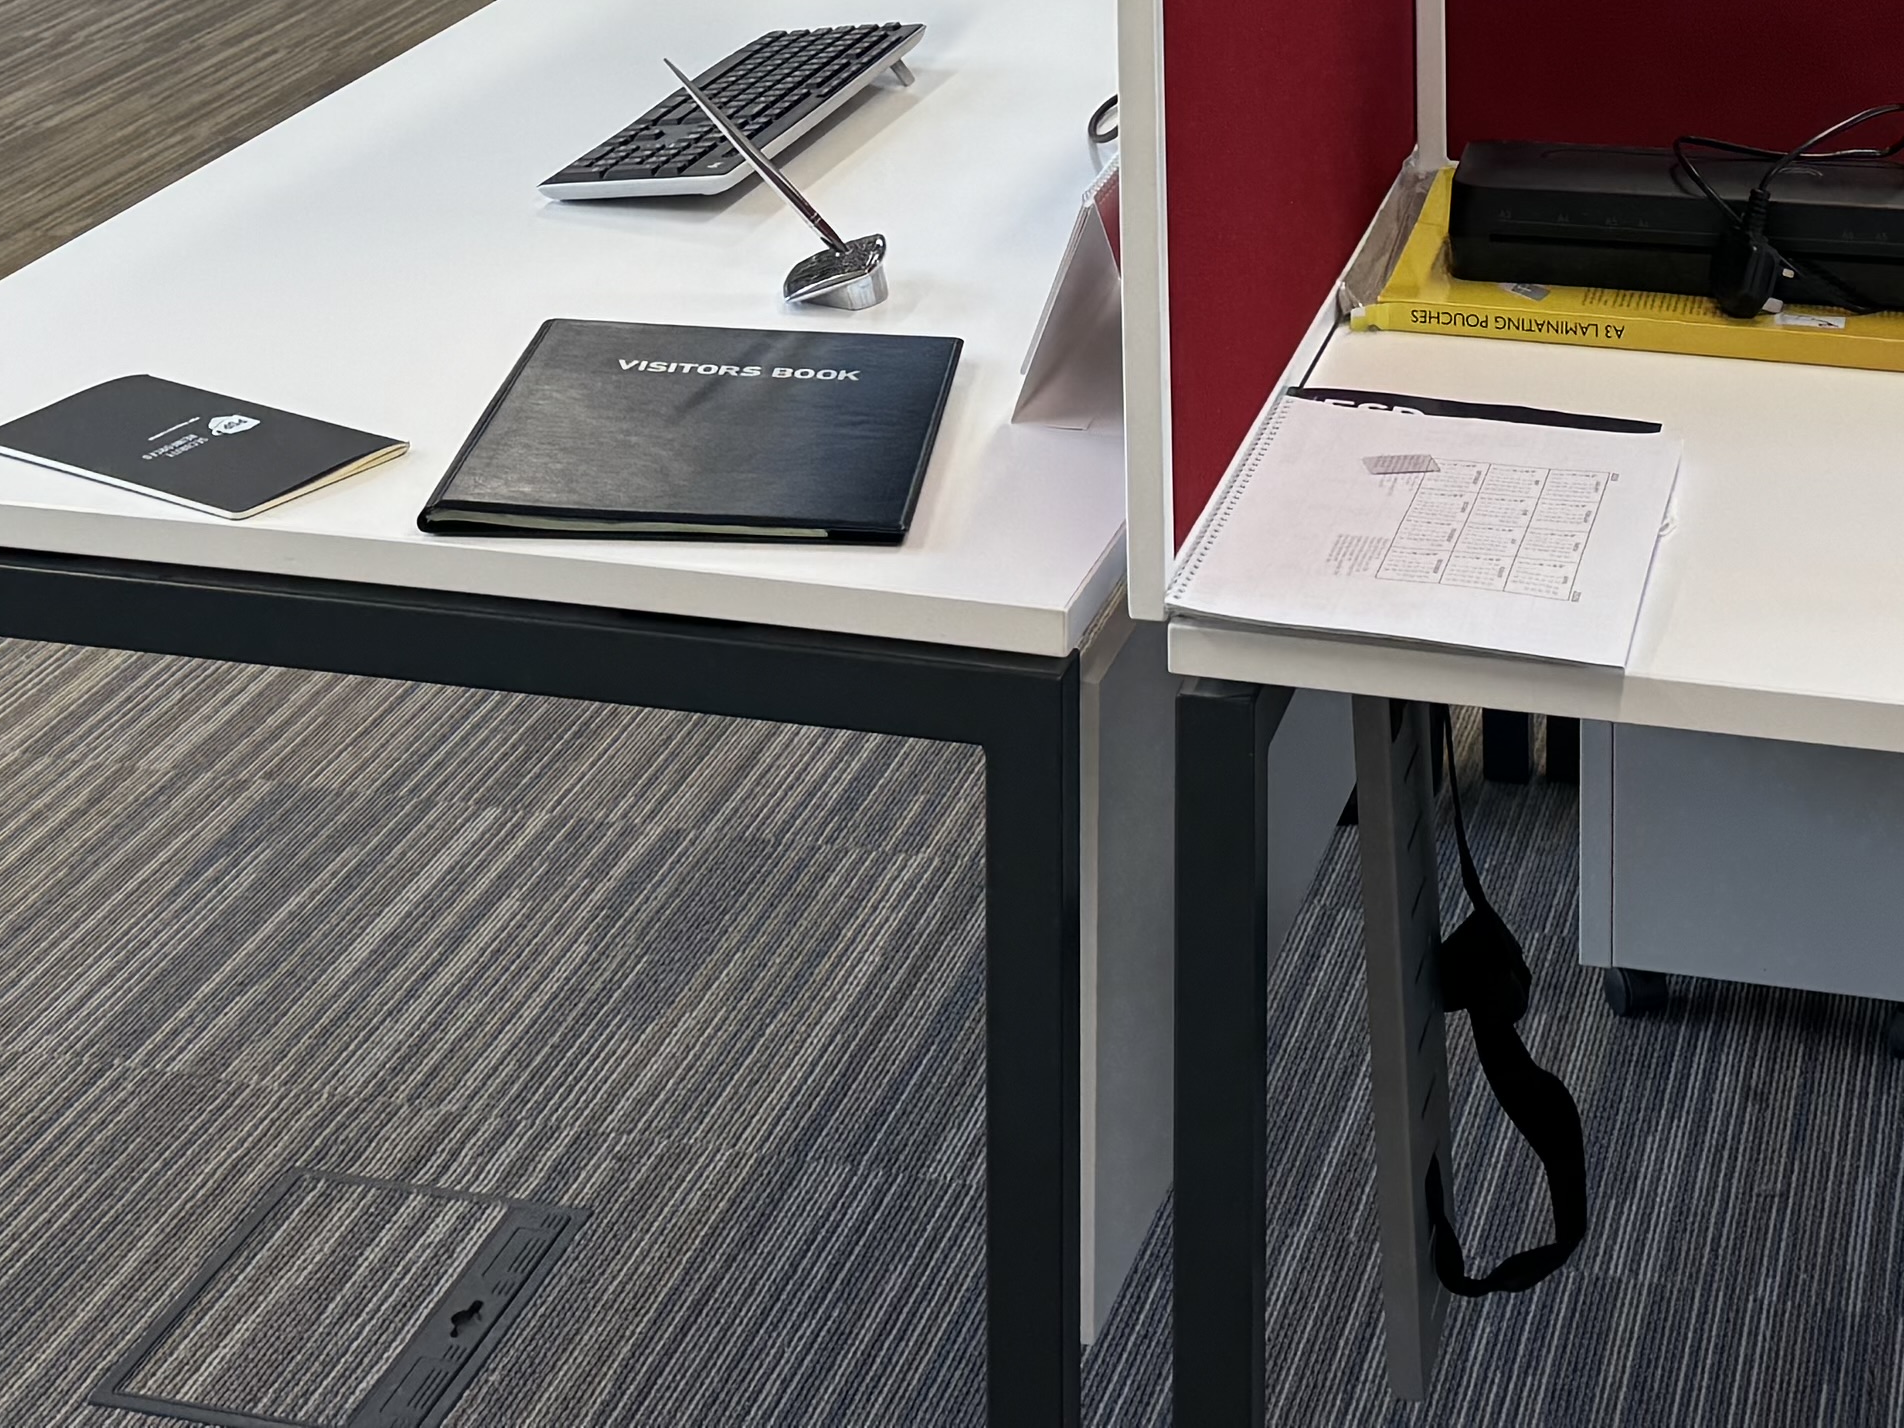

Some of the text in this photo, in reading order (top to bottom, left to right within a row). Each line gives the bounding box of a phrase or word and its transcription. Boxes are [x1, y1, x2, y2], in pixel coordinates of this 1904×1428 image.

[1411, 309, 1624, 338] A3 LAMINATING POUCHES
[618, 359, 861, 381] VISITORS BOOK
